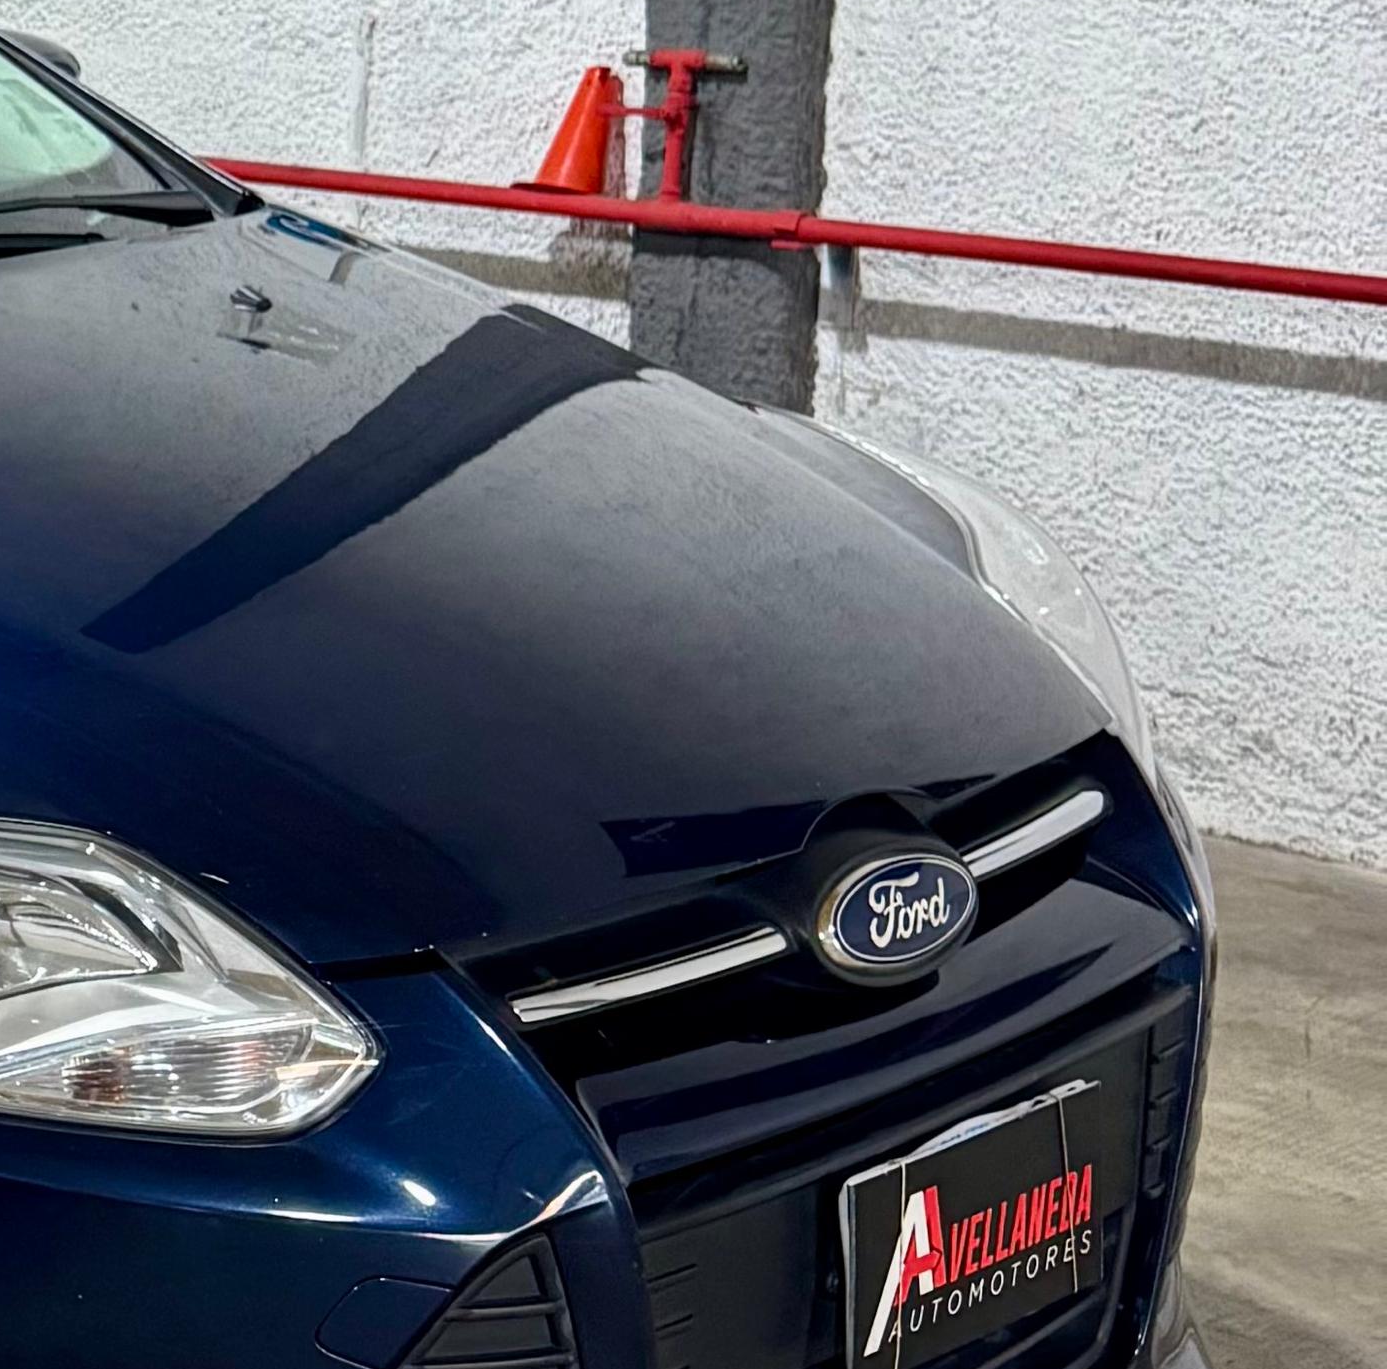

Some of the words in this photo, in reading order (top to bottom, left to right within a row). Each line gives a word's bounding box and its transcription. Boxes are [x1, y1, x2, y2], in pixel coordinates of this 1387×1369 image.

[868, 871, 950, 948] Ford
[864, 1164, 1092, 1357] AVELLANEDA
[888, 1229, 1092, 1343] AUTOMOTORES
